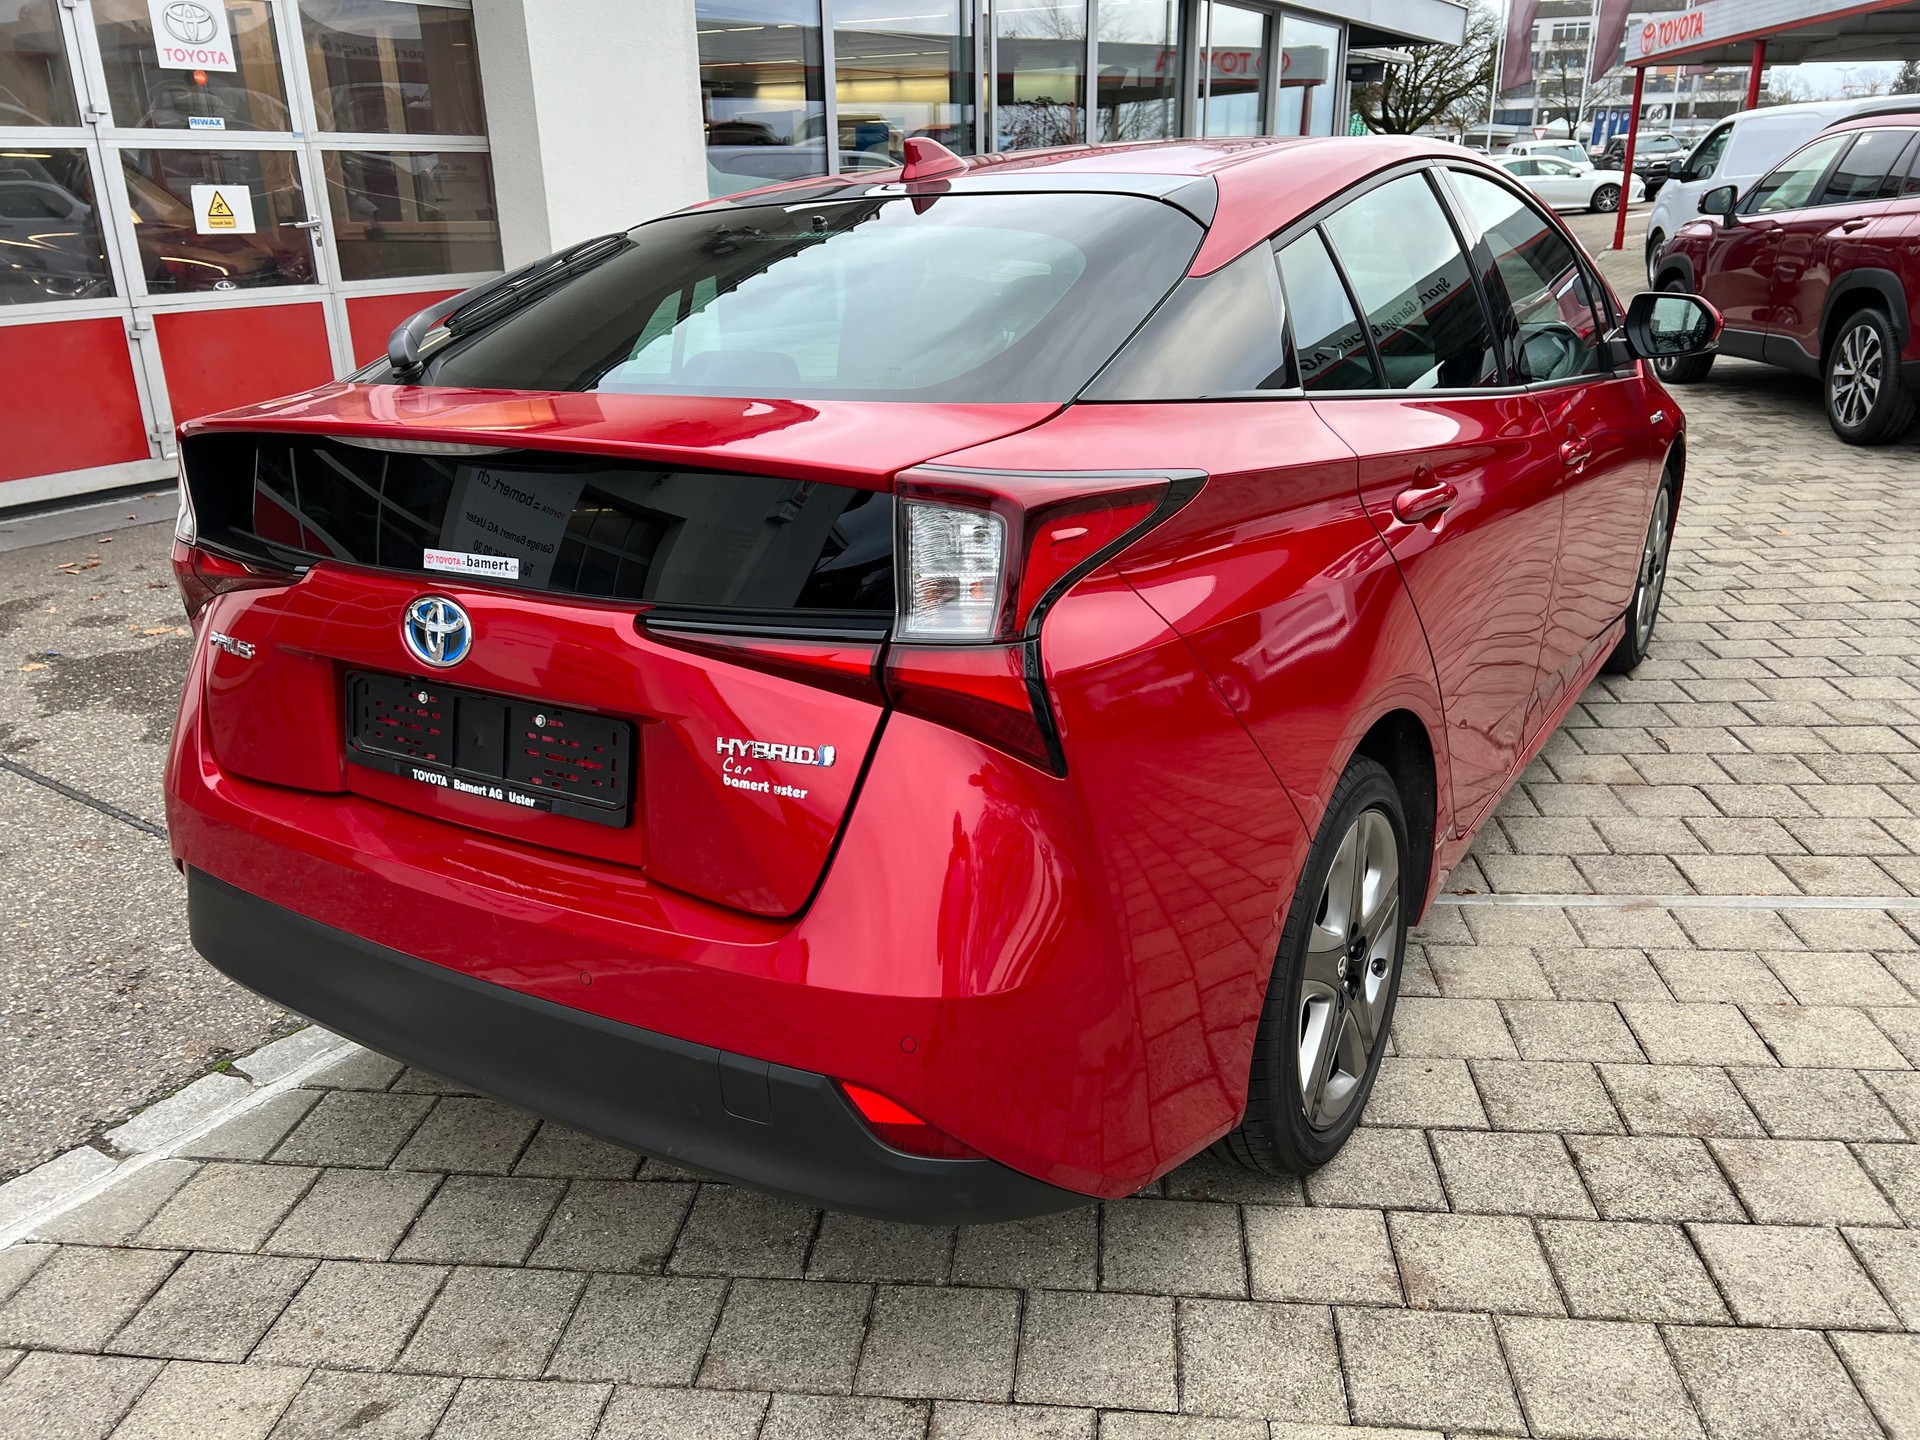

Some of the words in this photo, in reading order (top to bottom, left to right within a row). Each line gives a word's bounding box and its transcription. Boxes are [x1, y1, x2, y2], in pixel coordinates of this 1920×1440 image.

[1660, 11, 1704, 48] TOYOTA
[164, 48, 229, 65] TOYOTA
[190, 118, 222, 126] RIWAX
[435, 555, 461, 566] TOYOTA
[716, 736, 815, 765] HYBRID
[722, 756, 752, 775] Car
[412, 768, 448, 787] TOYOTA
[453, 778, 487, 796] Bamert
[488, 787, 503, 800] AG
[508, 791, 535, 807] Uster
[723, 773, 769, 793] bamert
[773, 784, 808, 799] uster
